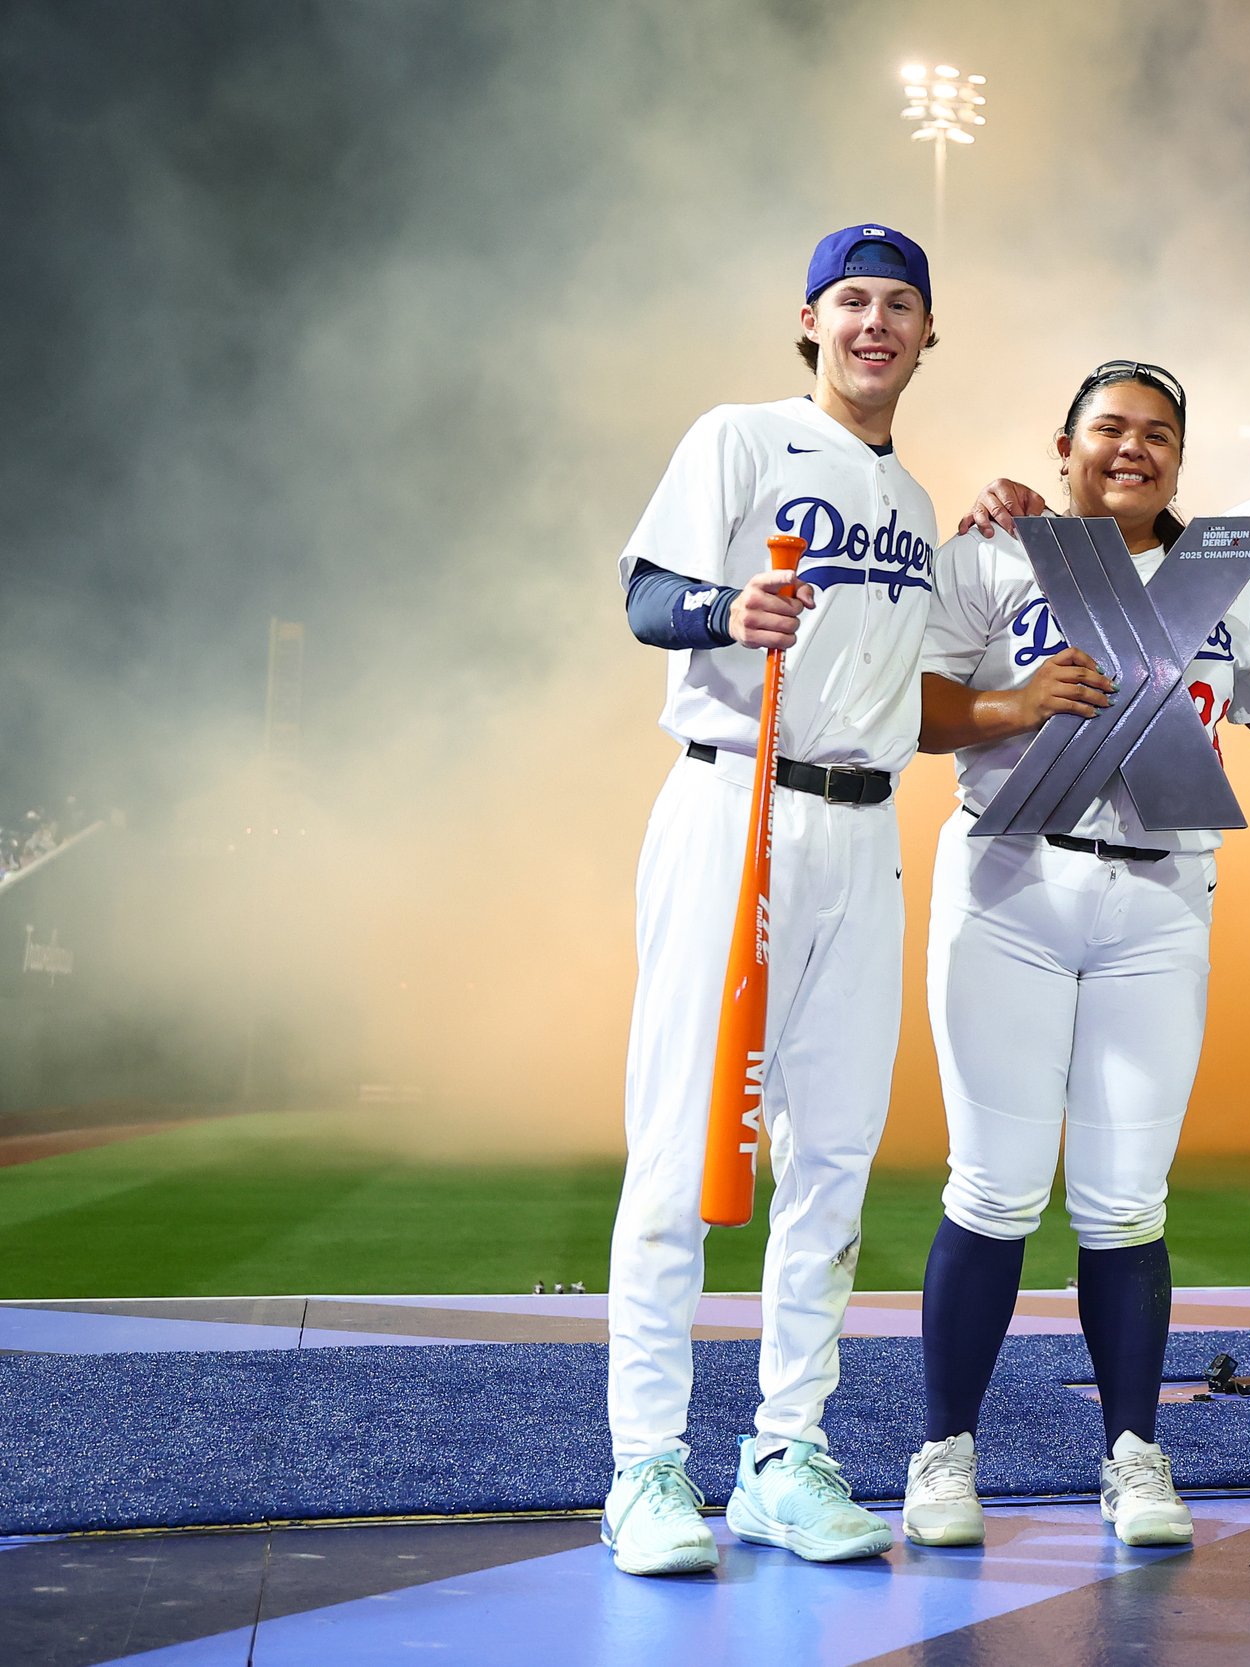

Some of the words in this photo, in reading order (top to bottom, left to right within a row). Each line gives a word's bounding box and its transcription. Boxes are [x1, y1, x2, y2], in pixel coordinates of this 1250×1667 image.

[775, 497, 933, 604] Dodger
[1203, 531, 1230, 539] HOME
[1230, 530, 1250, 539] RUN
[1179, 551, 1202, 560] 2025
[755, 905, 765, 966] marucci
